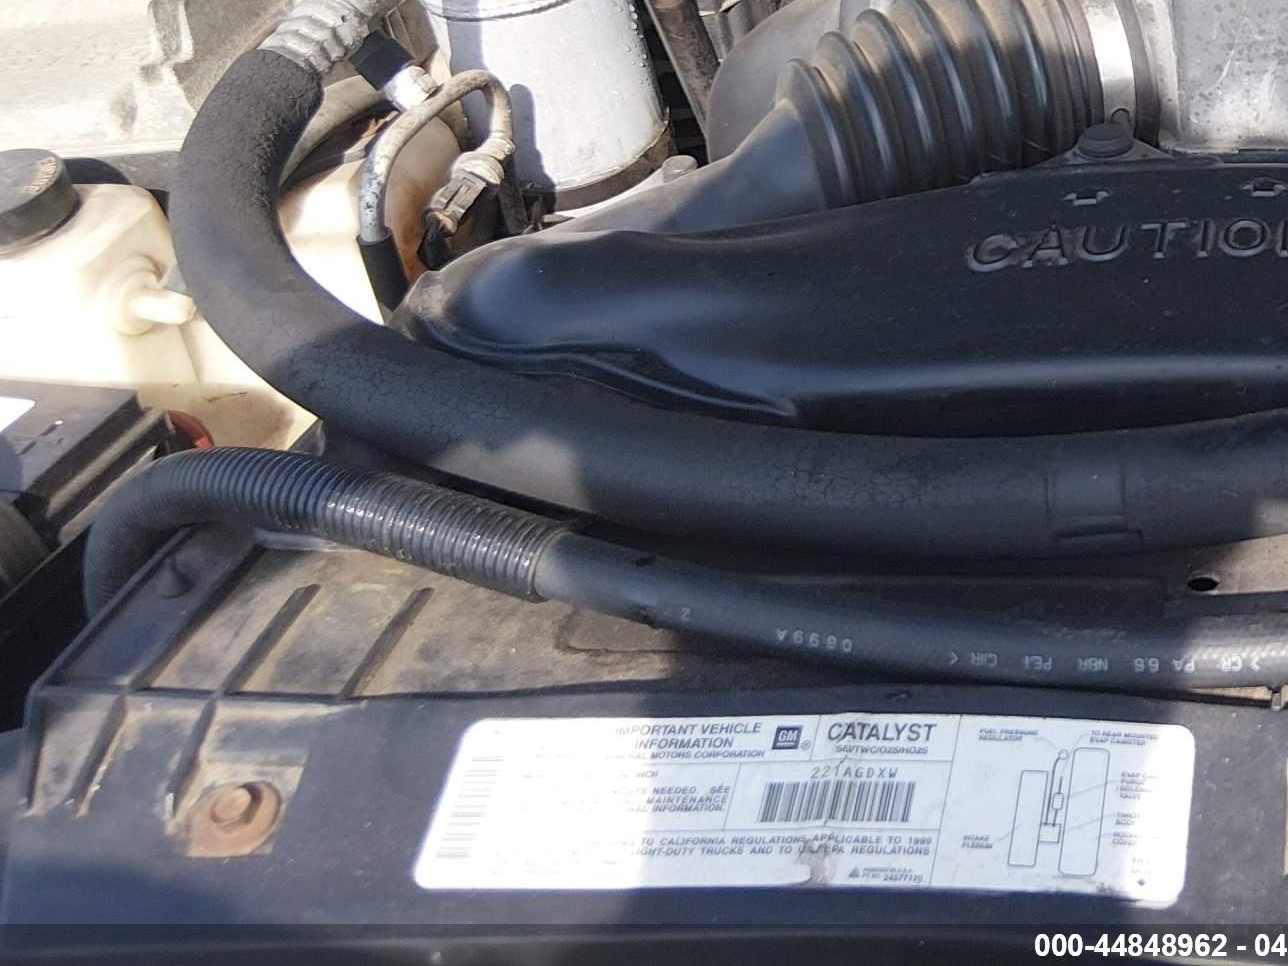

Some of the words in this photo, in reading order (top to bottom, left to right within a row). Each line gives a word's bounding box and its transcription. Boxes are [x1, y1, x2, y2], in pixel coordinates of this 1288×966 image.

[680, 607, 692, 623] 2
[1078, 656, 1109, 673] NBR
[1133, 657, 1160, 674] 6.6
[1172, 656, 1196, 675] PA
[616, 723, 698, 736] IMPORTANT
[701, 721, 763, 734] VEHICLE
[777, 728, 799, 742] GM
[828, 722, 937, 742] CATALYST
[635, 737, 735, 750] INFORMATION
[650, 750, 691, 760] MOTORS
[694, 749, 766, 759] CORPORATION
[710, 784, 732, 794] SEE
[646, 794, 729, 805] MAINTENANCE
[641, 837, 655, 847] TO
[659, 836, 726, 846] CALIFORNIA
[731, 835, 807, 845] REGULATIONS
[812, 834, 882, 845] APPLICABLE
[888, 835, 902, 845] TO
[701, 845, 744, 856] TRUCKS
[749, 845, 771, 855] AND
[774, 845, 793, 855] TO
[850, 845, 930, 856] REGULATIONS
